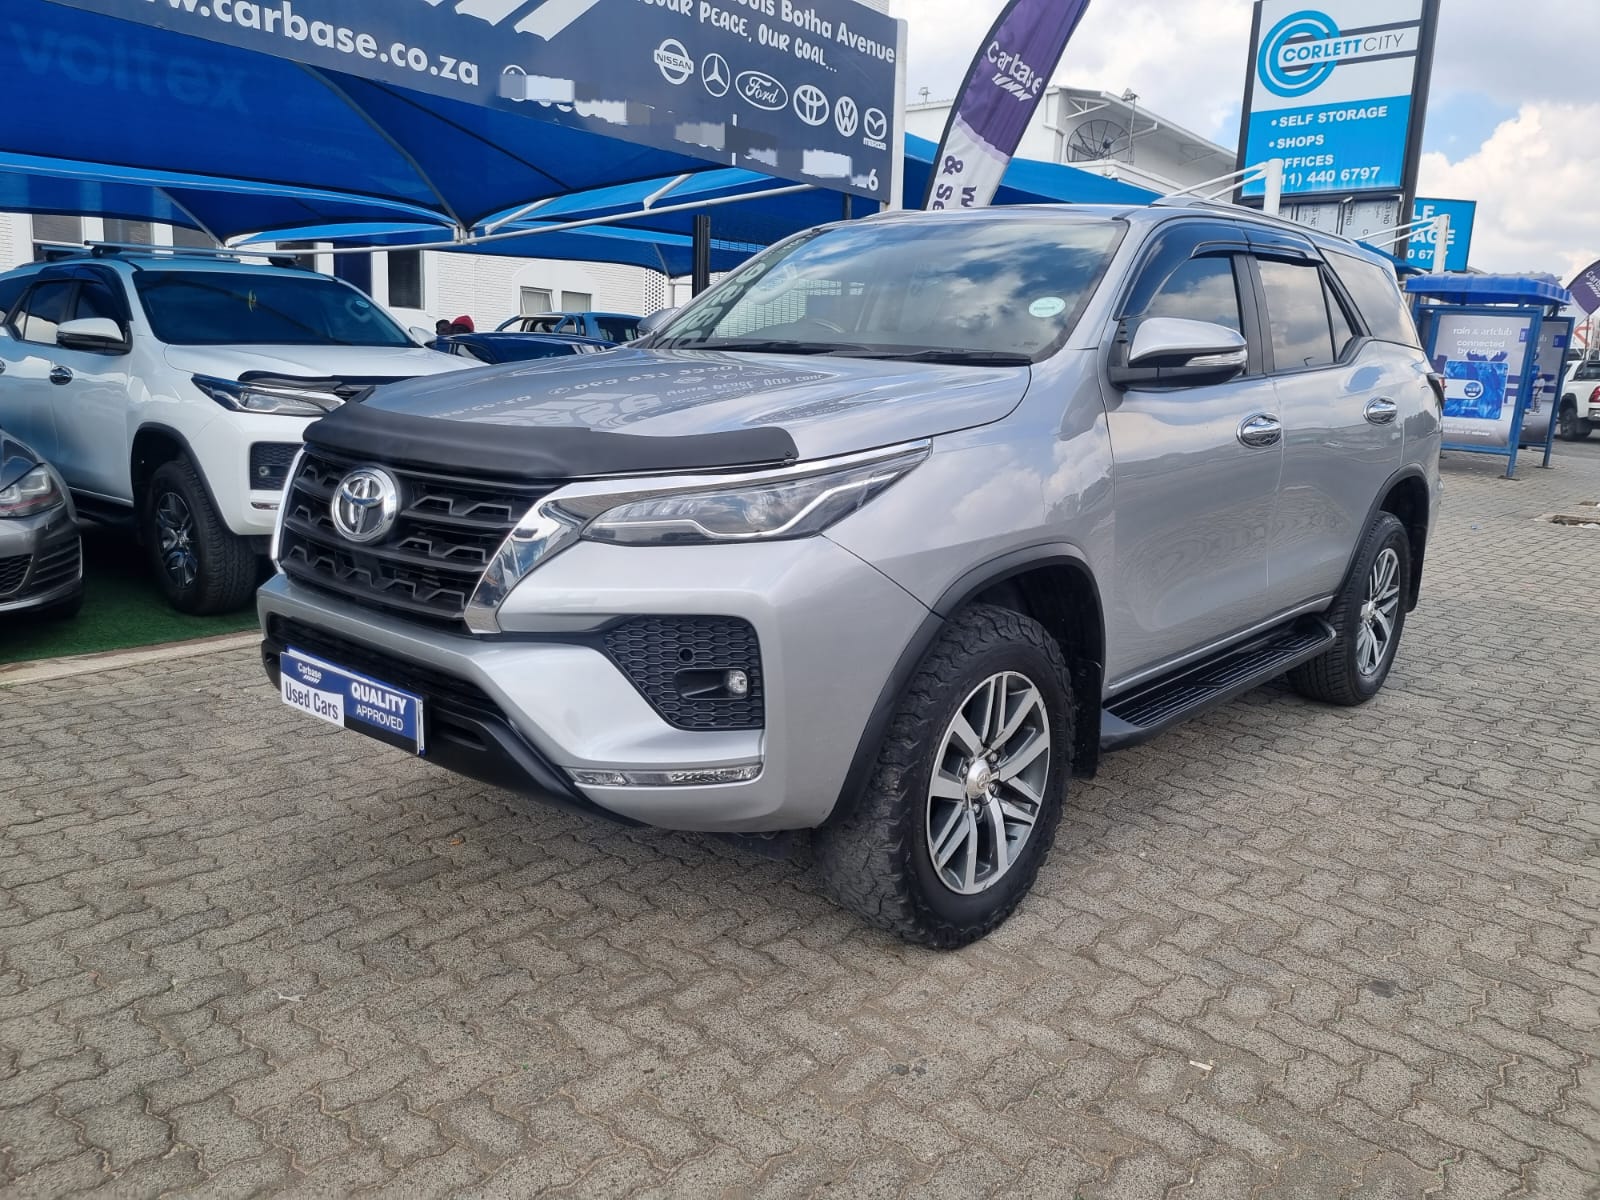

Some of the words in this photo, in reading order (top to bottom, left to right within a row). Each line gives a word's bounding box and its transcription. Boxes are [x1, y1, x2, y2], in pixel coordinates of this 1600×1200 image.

[699, 1, 752, 43] PEACE,
[758, 23, 790, 52] OUR
[794, 37, 837, 73] GOAL...
[780, 0, 832, 39] Botha
[836, 22, 895, 63] Avenue
[656, 52, 692, 71] NISSAN
[745, 76, 779, 104] Ford
[1279, 113, 1313, 128] SELF
[1318, 105, 1388, 124] STORAGE
[1276, 134, 1325, 150] SHOPS
[943, 155, 963, 176] &
[1281, 173, 1302, 188] 11)
[1306, 170, 1336, 185] 440
[1340, 166, 1381, 183] 6797
[932, 183, 954, 211] Se
[1411, 203, 1436, 221] LF
[297, 662, 322, 679] Carbase
[285, 681, 311, 709] Used
[313, 692, 338, 720] Cars
[351, 682, 407, 715] QUALITY
[356, 704, 404, 731] APPROVED
